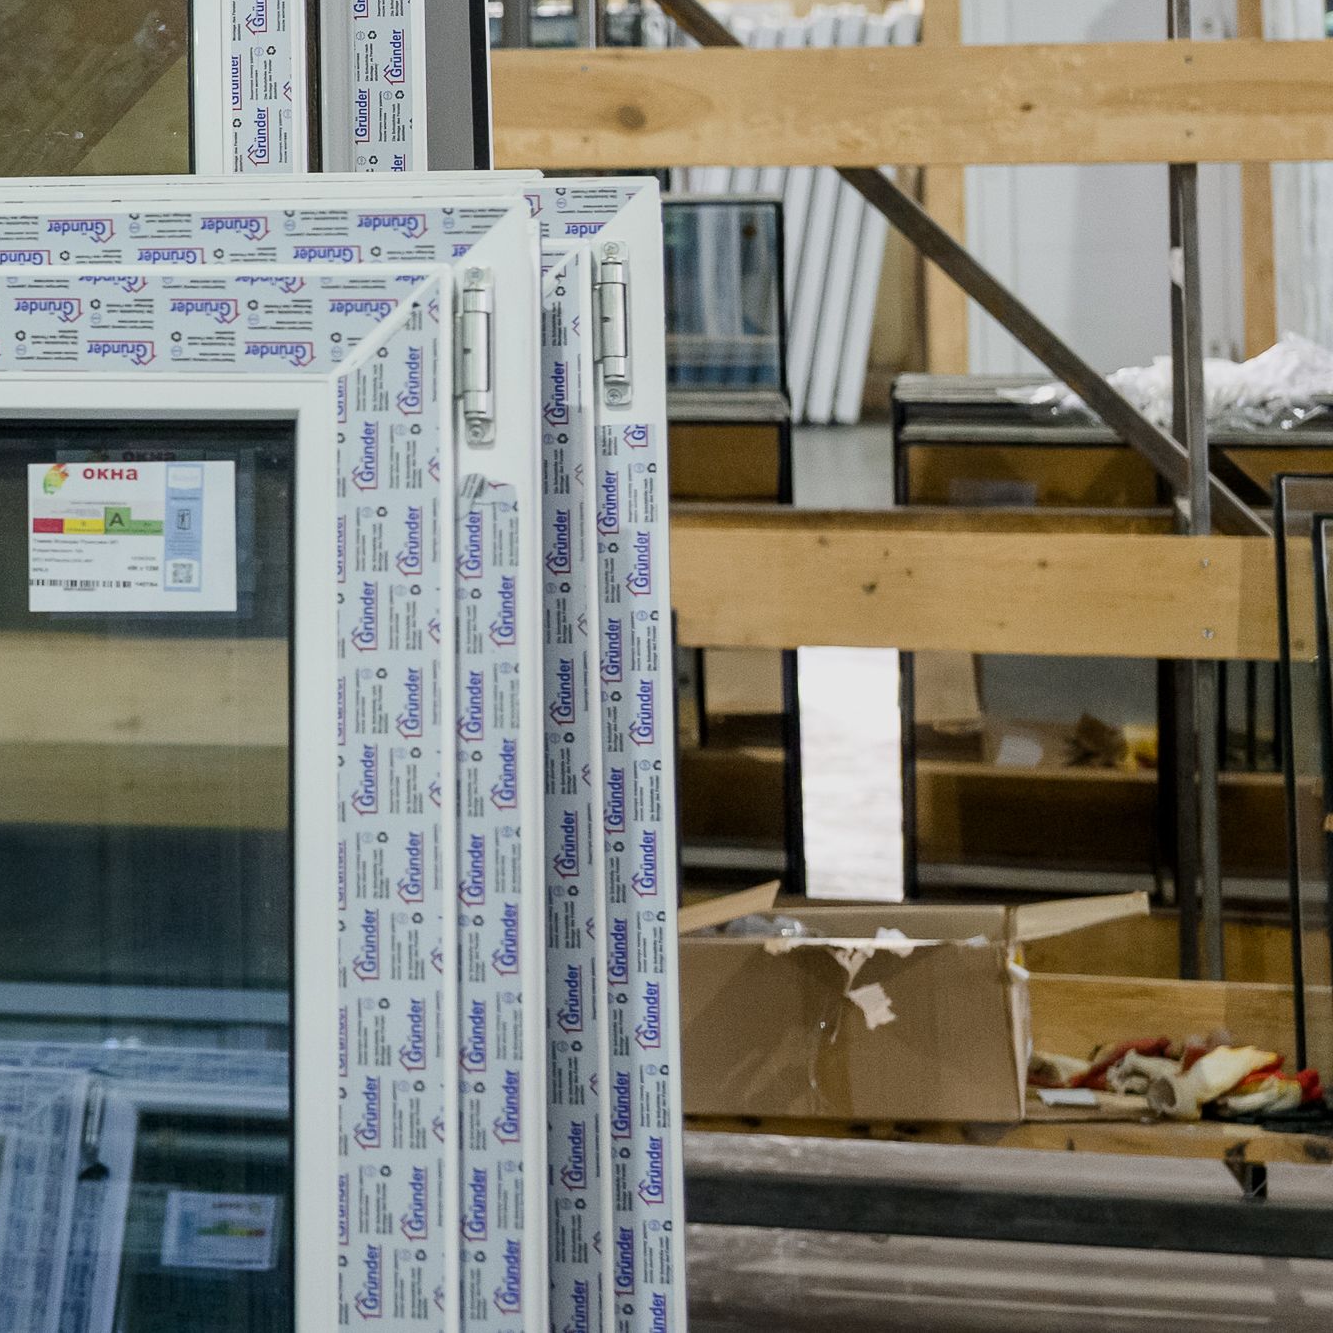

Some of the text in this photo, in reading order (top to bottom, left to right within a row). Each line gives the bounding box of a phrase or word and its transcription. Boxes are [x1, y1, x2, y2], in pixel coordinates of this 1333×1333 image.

[252, 107, 265, 159] Gründer
[82, 467, 139, 481] окна
[603, 470, 618, 529] Gründer
[108, 512, 126, 527] A
[554, 508, 570, 569] Gründer
[635, 531, 650, 590] Gründer
[608, 617, 623, 677] Gründer
[608, 766, 625, 828] Gründer
[640, 829, 656, 890] Gründer
[647, 1136, 663, 1198] Gründer
